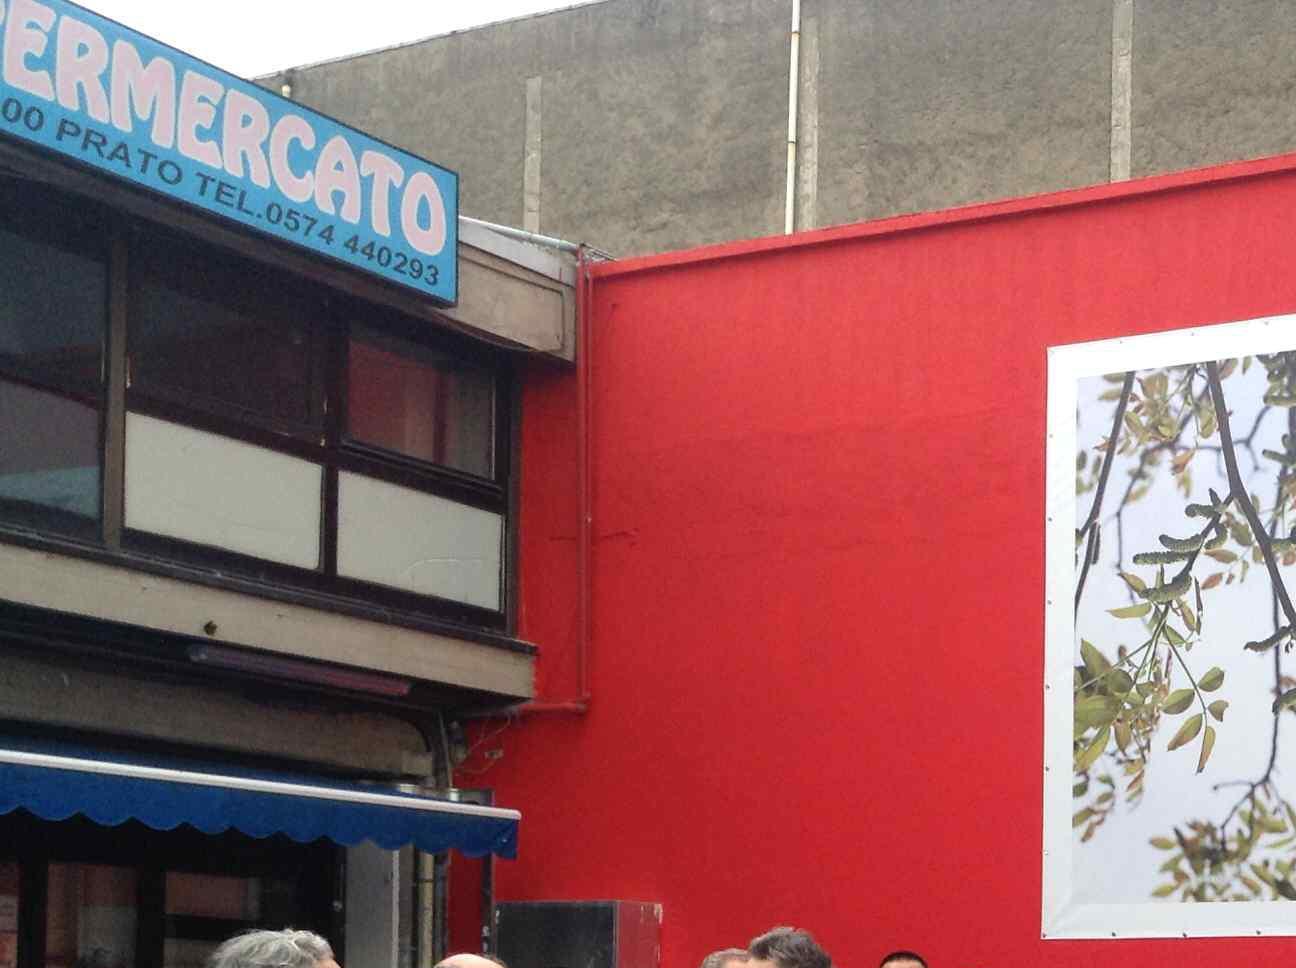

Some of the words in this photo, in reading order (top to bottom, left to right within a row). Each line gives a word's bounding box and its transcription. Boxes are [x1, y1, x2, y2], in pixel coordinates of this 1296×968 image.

[0, 0, 447, 256] ERMERCATO
[56, 118, 184, 186] PRATO
[343, 234, 440, 287] 440293
